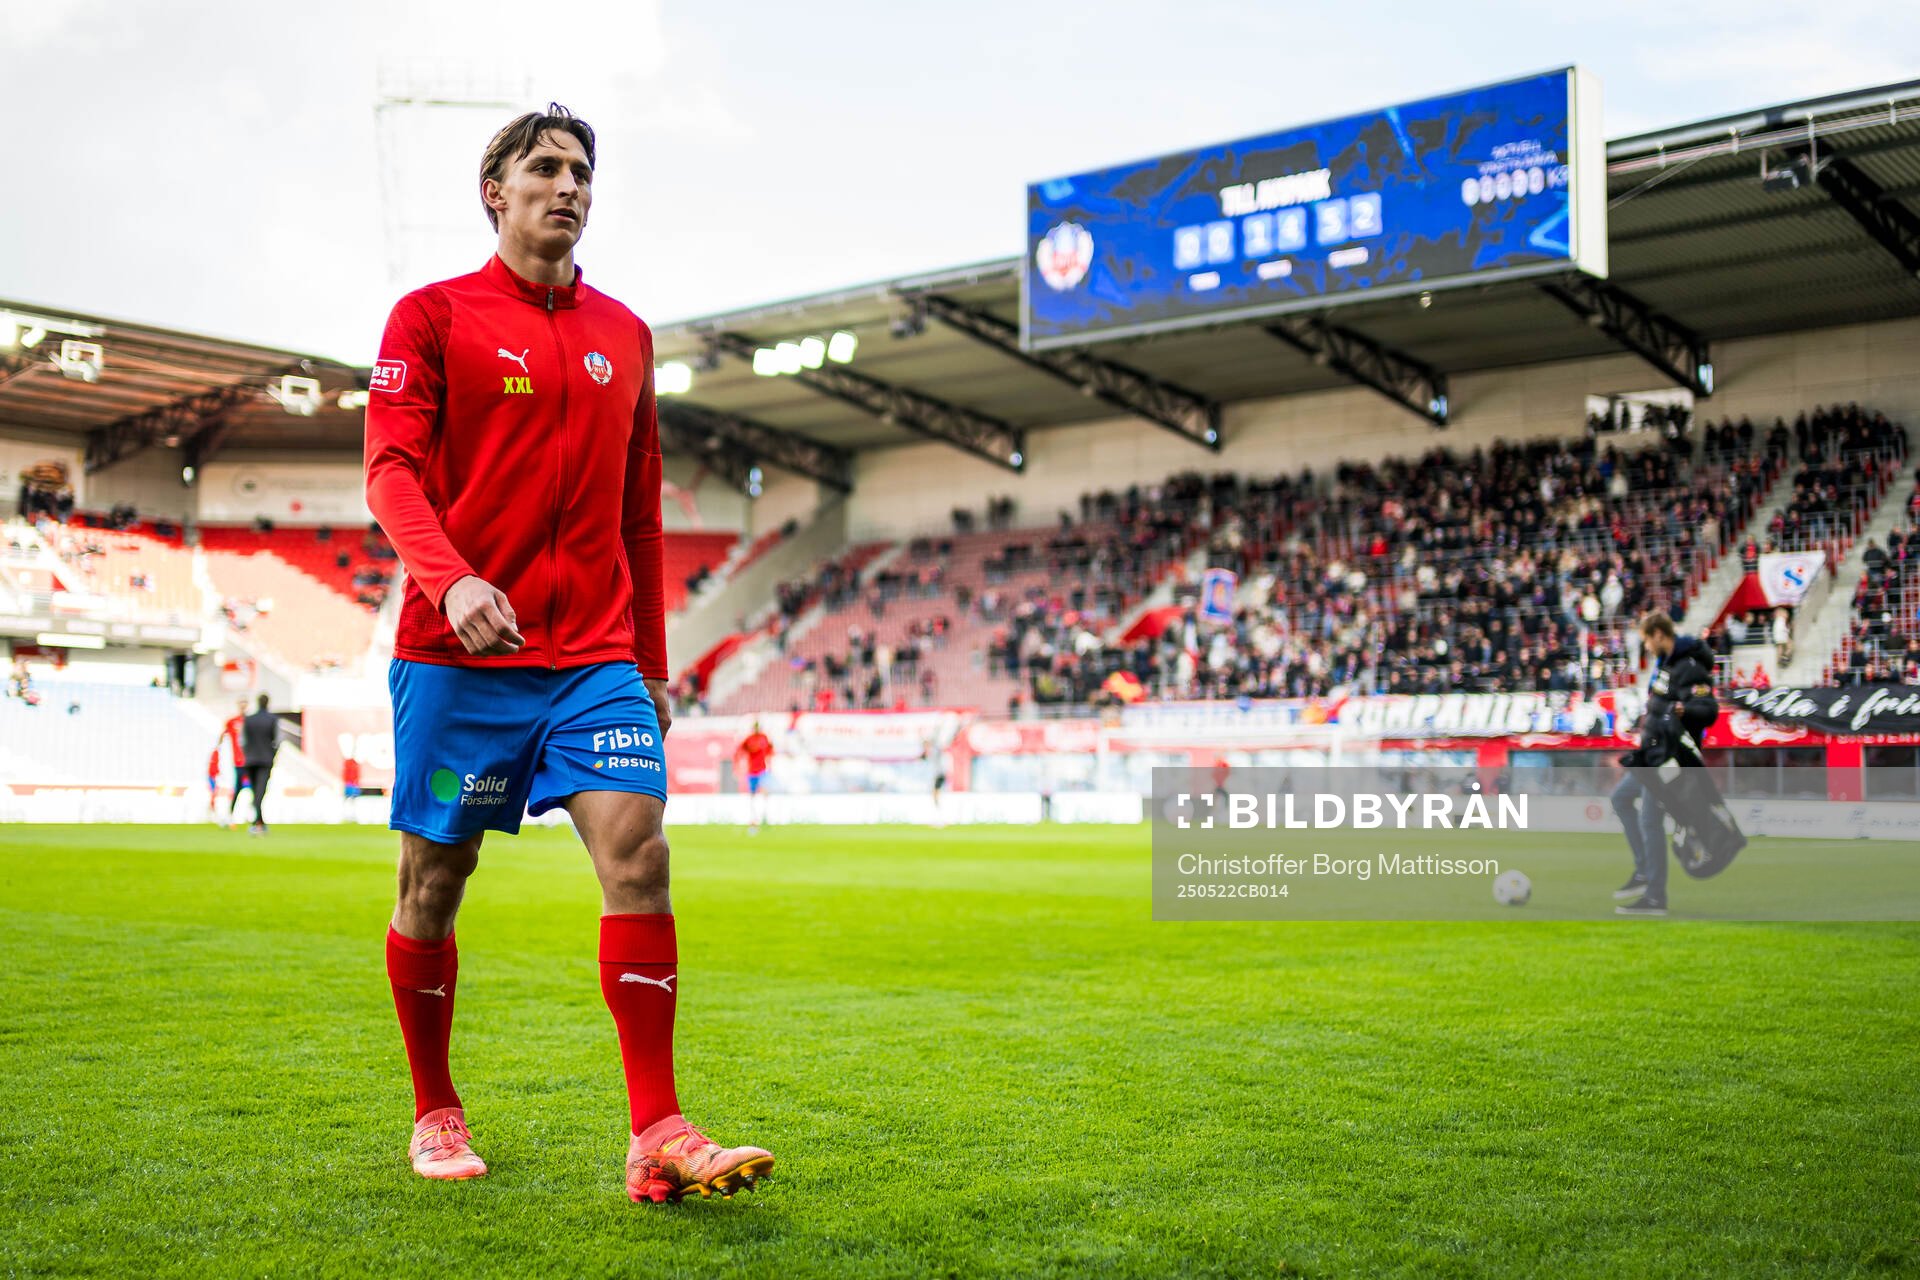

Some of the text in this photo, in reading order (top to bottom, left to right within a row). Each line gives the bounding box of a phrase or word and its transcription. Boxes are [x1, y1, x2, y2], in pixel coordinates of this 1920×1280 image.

[503, 376, 534, 395] XXL
[1828, 694, 1851, 718] i
[593, 727, 654, 752] Fibio
[608, 757, 661, 772] Resurs
[463, 773, 508, 792] Solid
